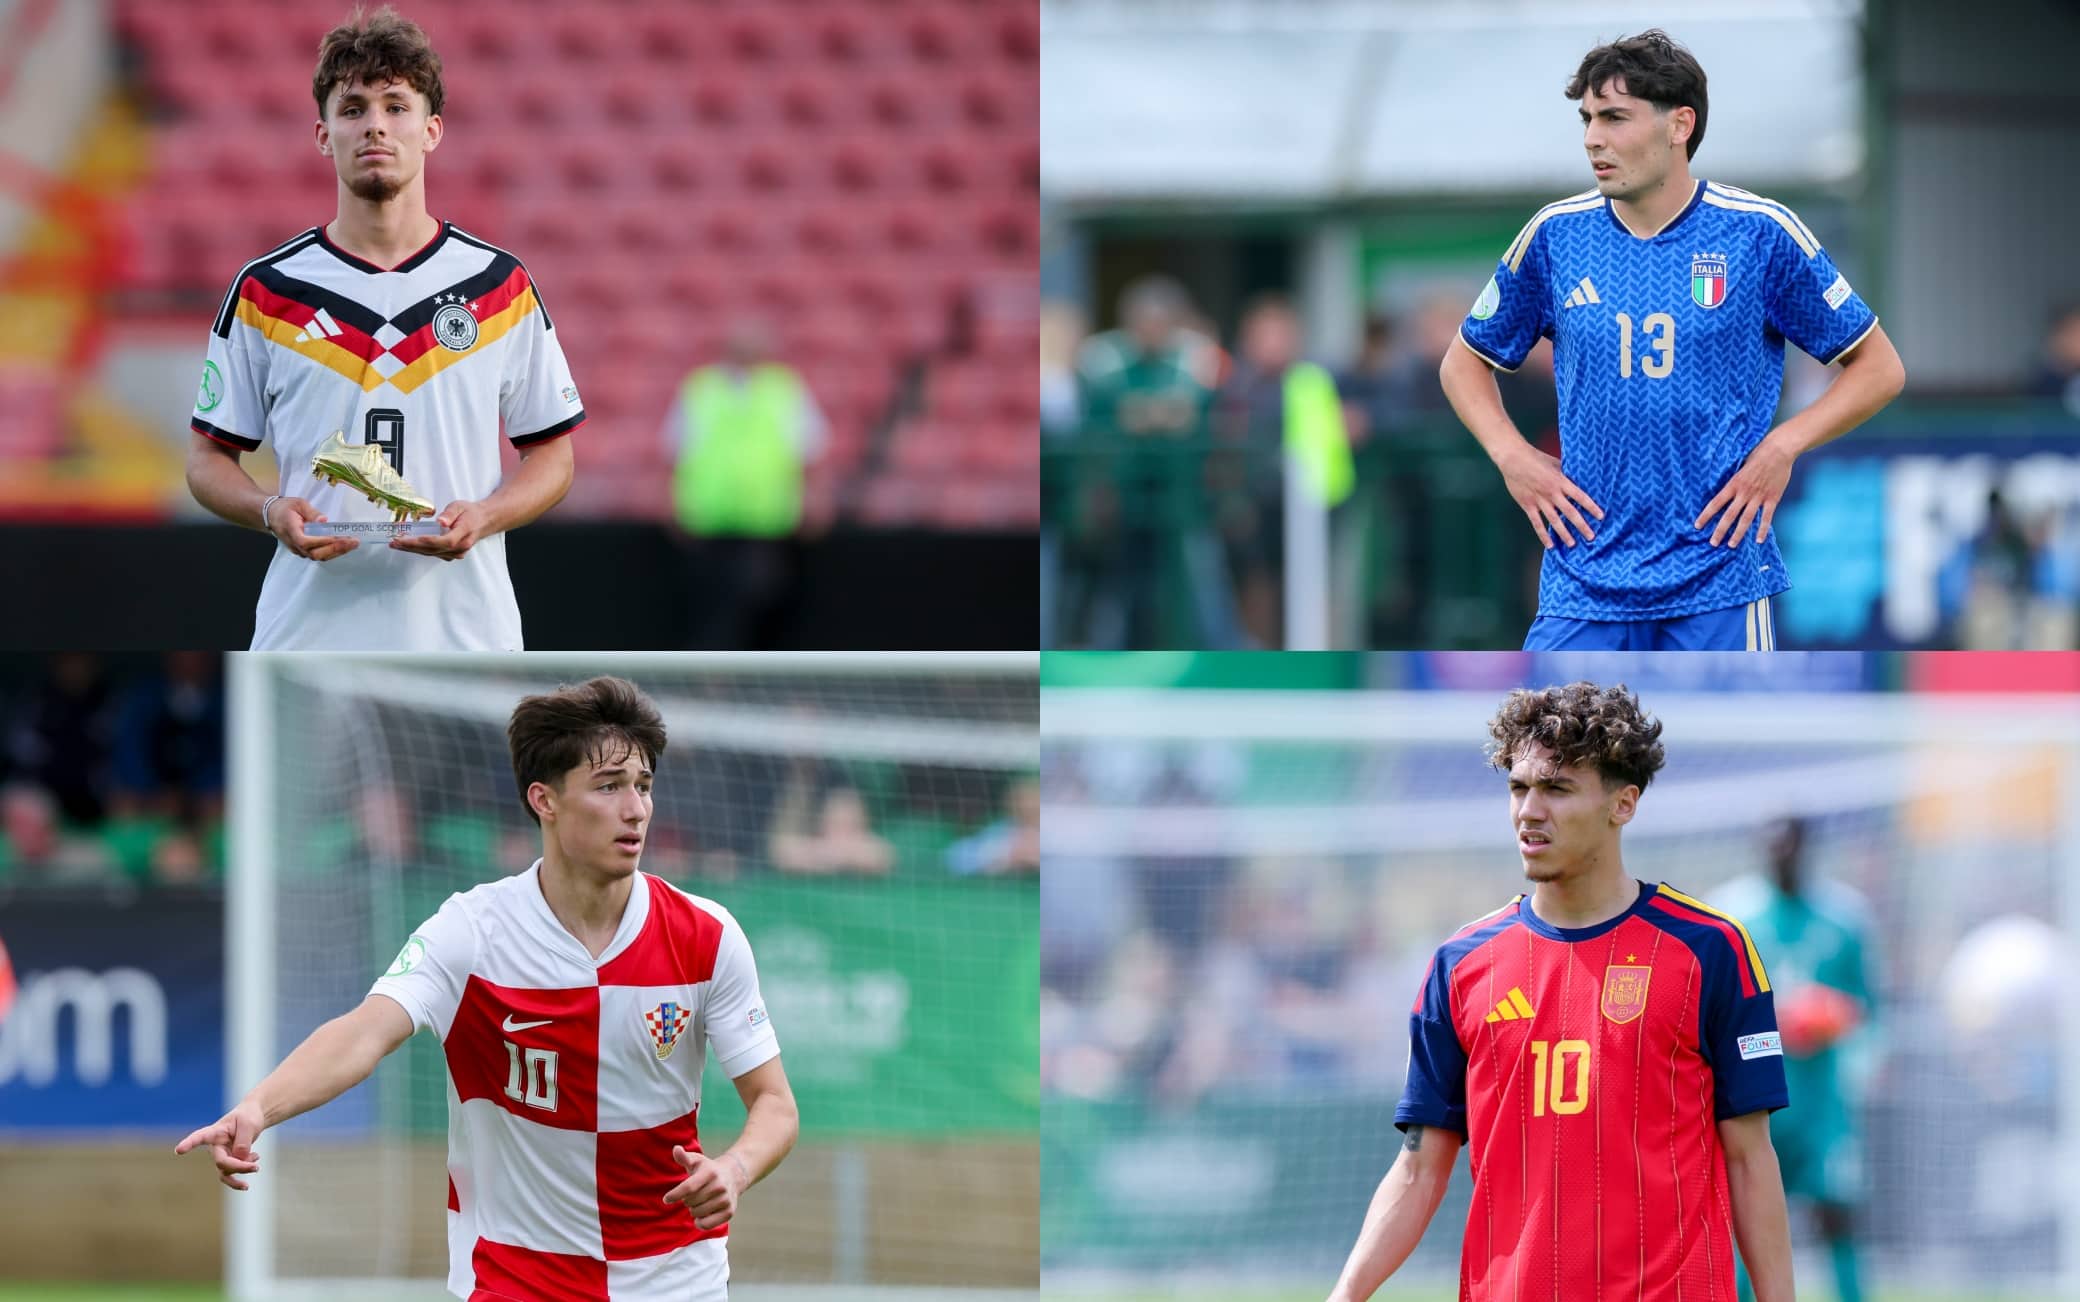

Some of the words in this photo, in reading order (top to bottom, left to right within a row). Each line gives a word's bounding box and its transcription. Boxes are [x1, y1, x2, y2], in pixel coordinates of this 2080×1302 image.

[1693, 265, 1723, 274] ITALIA
[1616, 312, 1676, 379] 13
[365, 408, 405, 477] 9
[333, 524, 350, 532] TOP
[352, 524, 374, 532] GOAL
[503, 1040, 559, 1112] 10
[1531, 1040, 1591, 1116] 10
